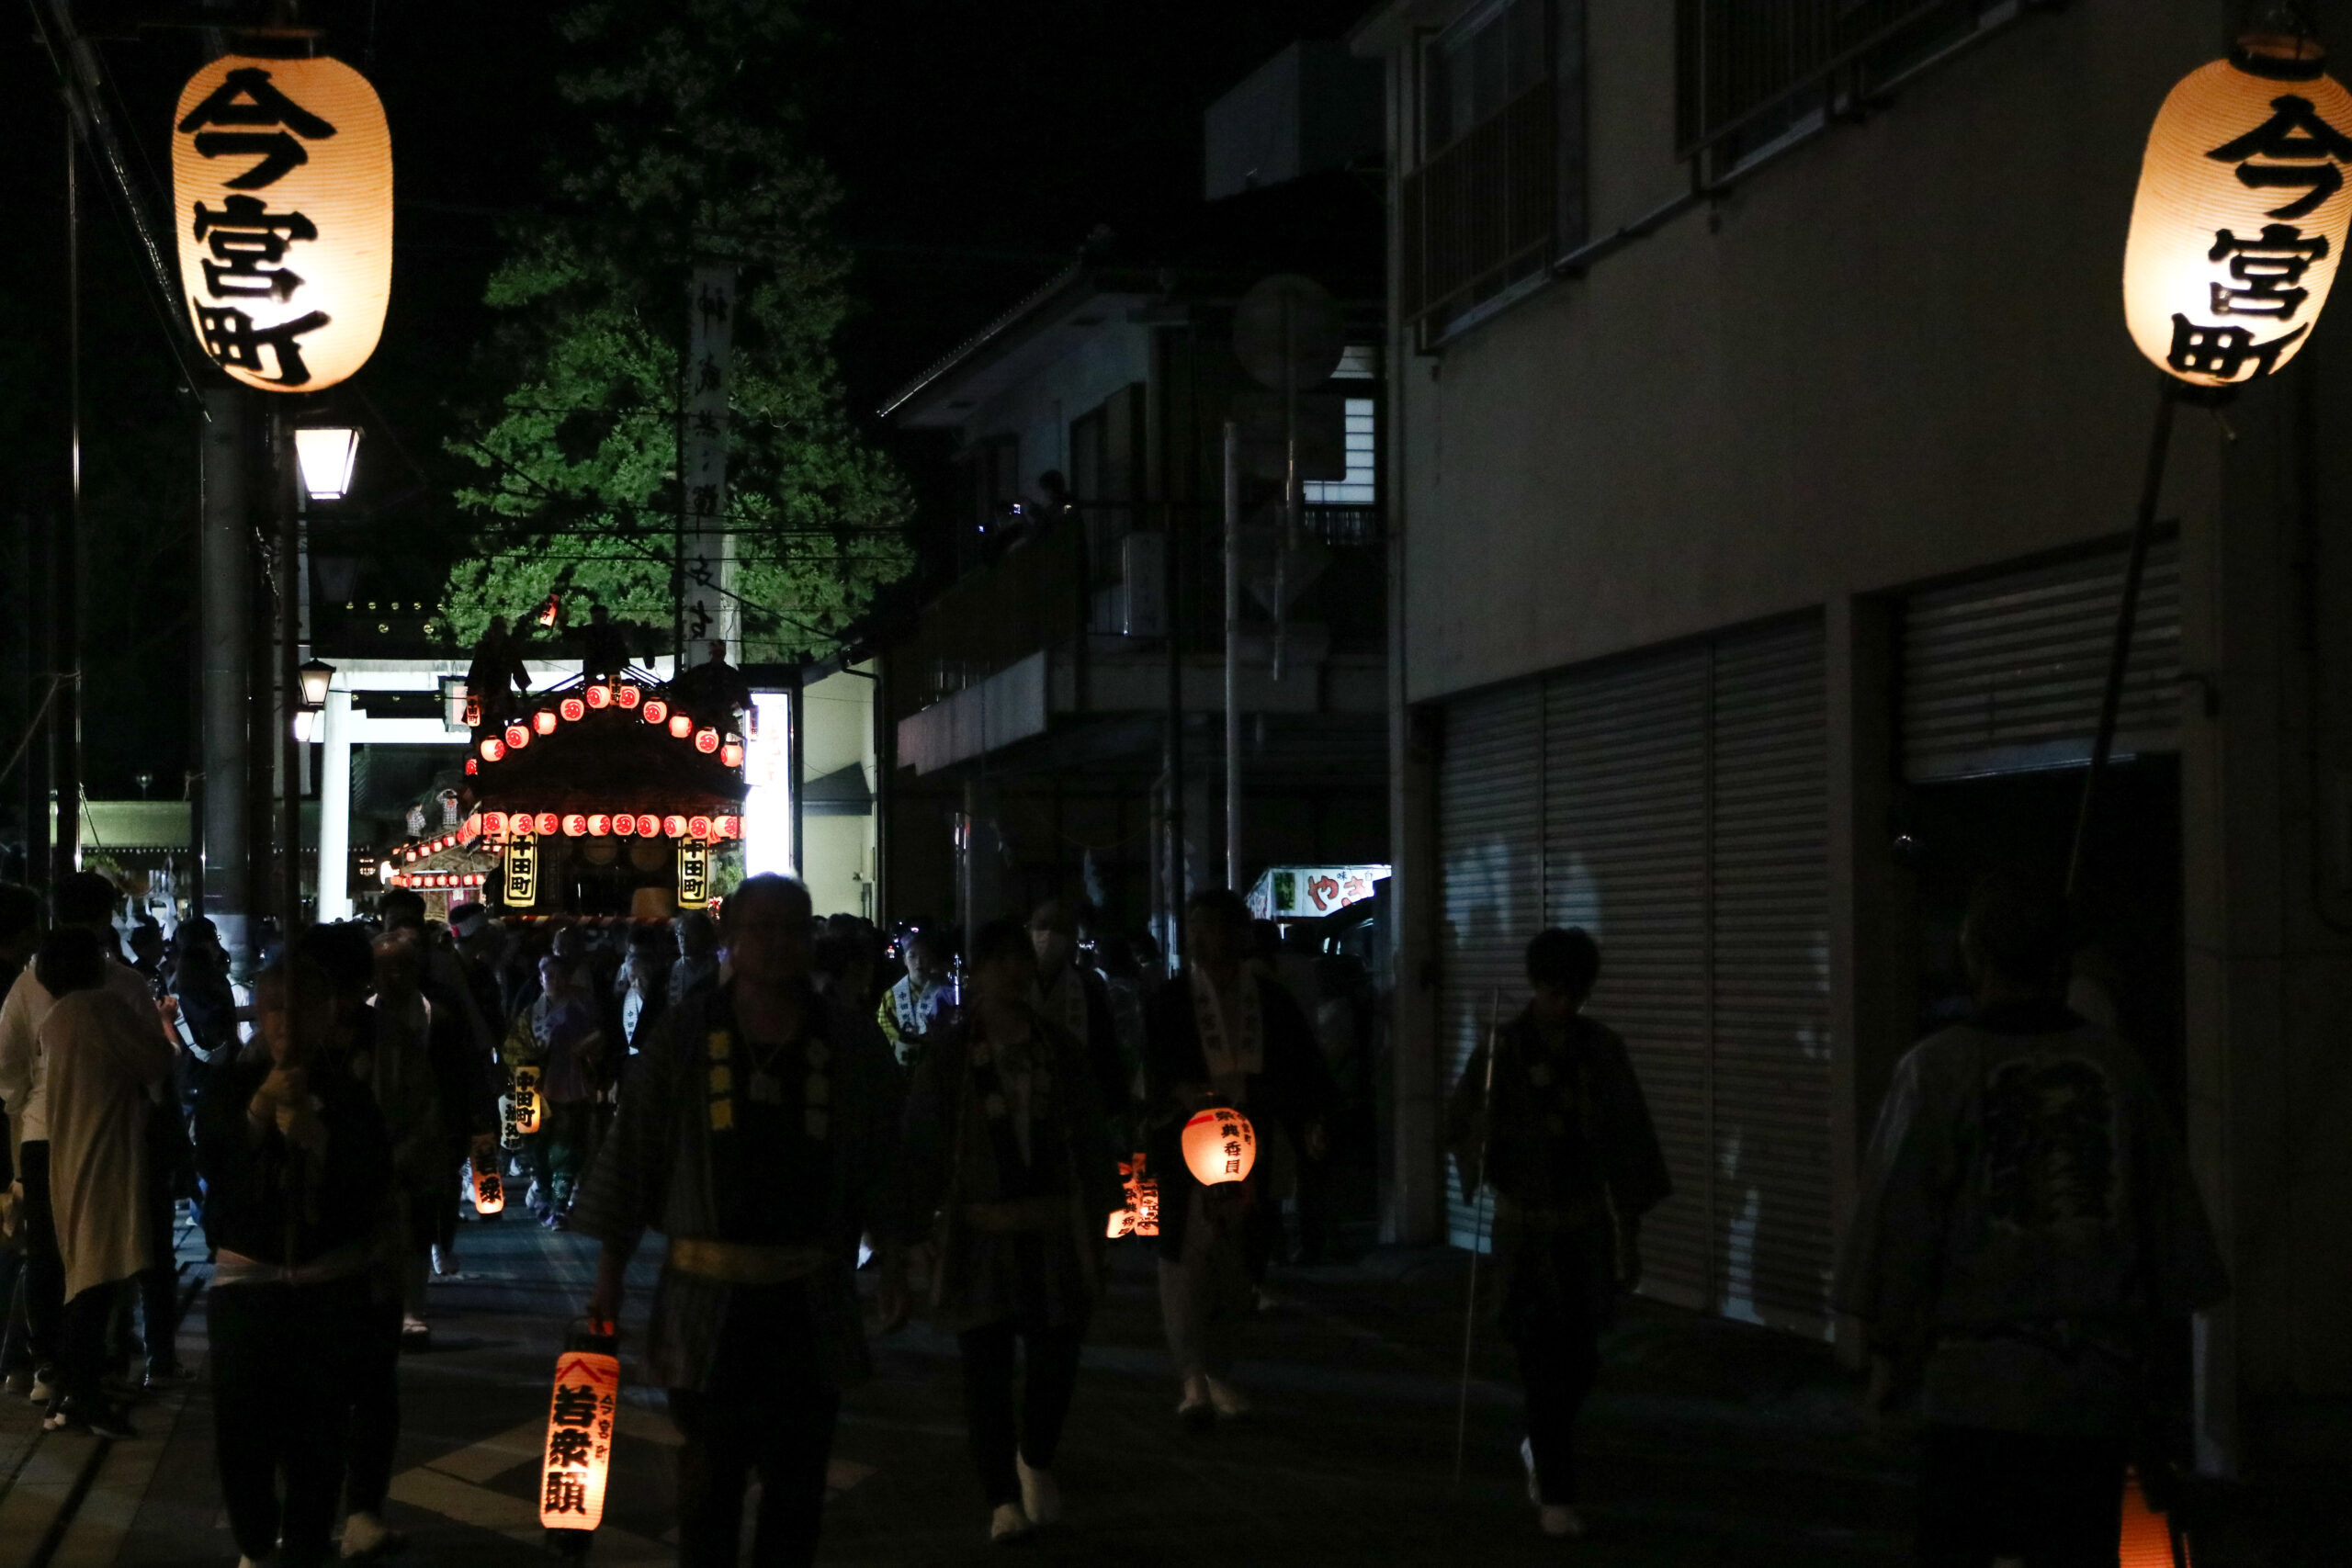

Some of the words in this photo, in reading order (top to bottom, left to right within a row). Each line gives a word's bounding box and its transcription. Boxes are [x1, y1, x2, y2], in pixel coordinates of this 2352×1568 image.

[177, 67, 338, 387] 今宮町
[2166, 94, 2352, 383] 今宮町
[516, 1071, 536, 1127] 中田町
[595, 1393, 614, 1463] 今宮町
